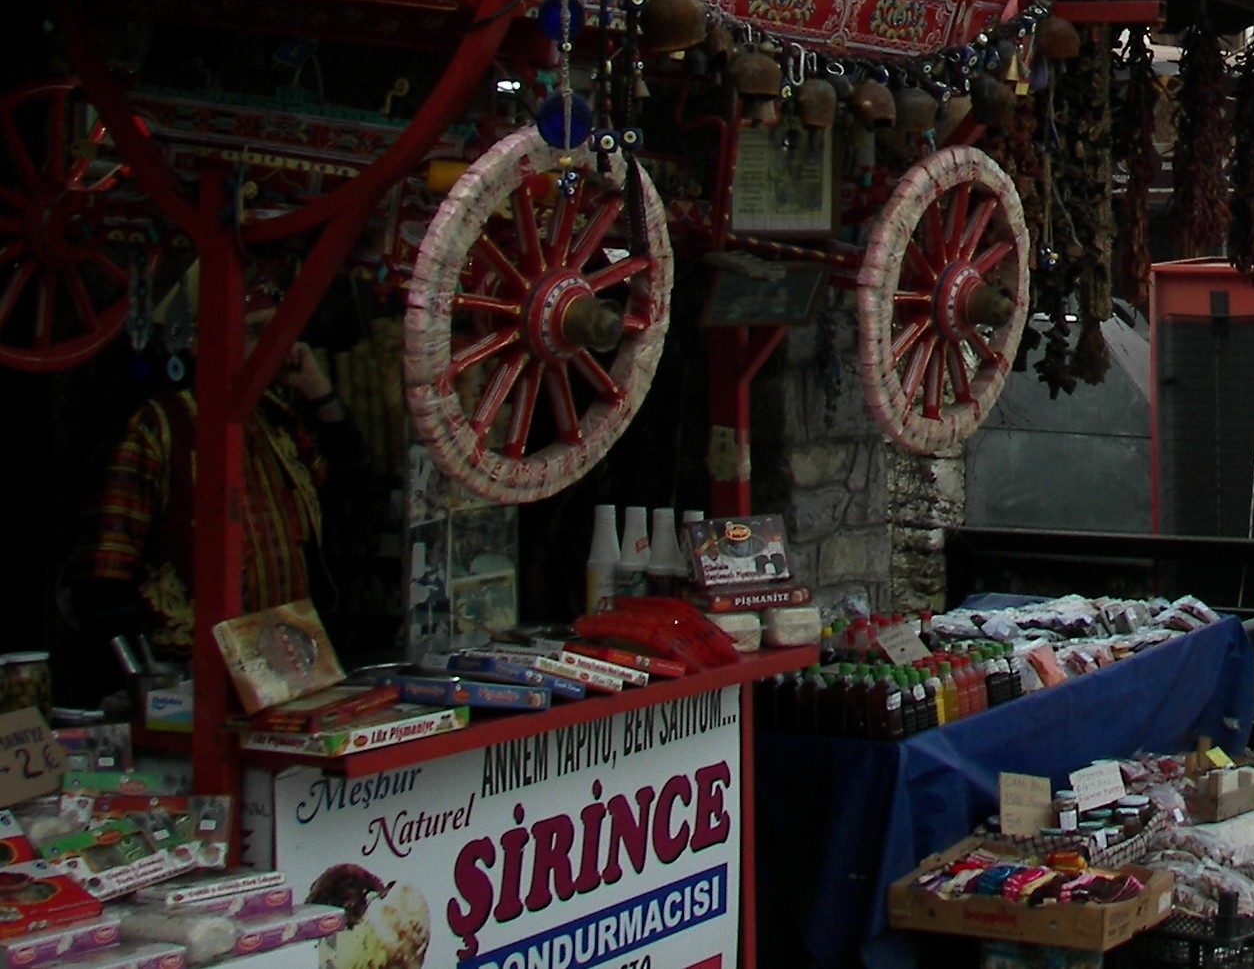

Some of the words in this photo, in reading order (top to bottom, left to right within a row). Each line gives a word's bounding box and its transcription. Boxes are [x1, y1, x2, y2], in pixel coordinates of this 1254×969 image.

[734, 592, 790, 607] PİŞMANİYE
[481, 731, 549, 798] ANNEM
[623, 705, 655, 757] BEN
[296, 765, 422, 824] Meşhur
[361, 792, 476, 858] Naturel
[446, 759, 732, 959] ŞİRİNCE
[478, 875, 721, 969] NDURMACISI
